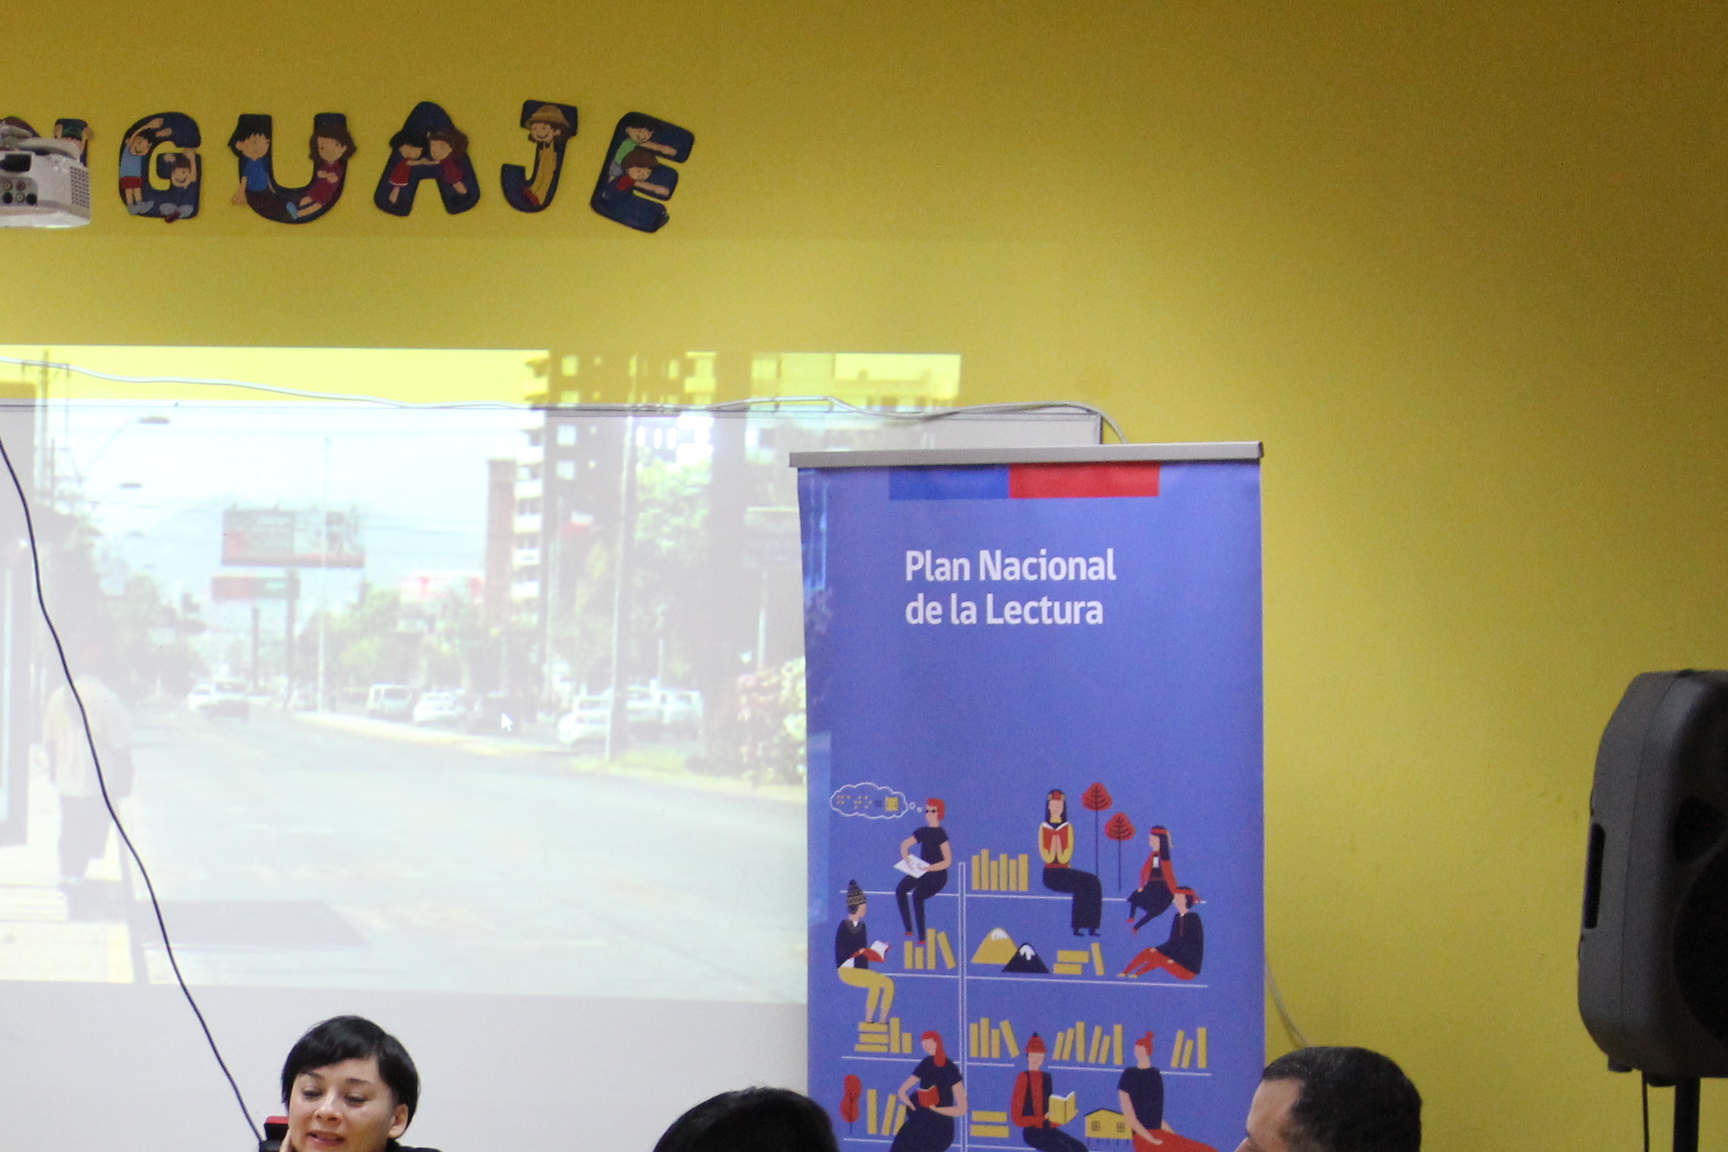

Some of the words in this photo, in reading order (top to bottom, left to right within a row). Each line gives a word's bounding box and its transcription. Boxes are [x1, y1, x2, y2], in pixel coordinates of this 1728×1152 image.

[905, 550, 971, 582] Plan
[978, 548, 1117, 582] Nacional
[905, 593, 942, 625] de
[951, 593, 977, 625] la
[986, 593, 1104, 625] Lectura
